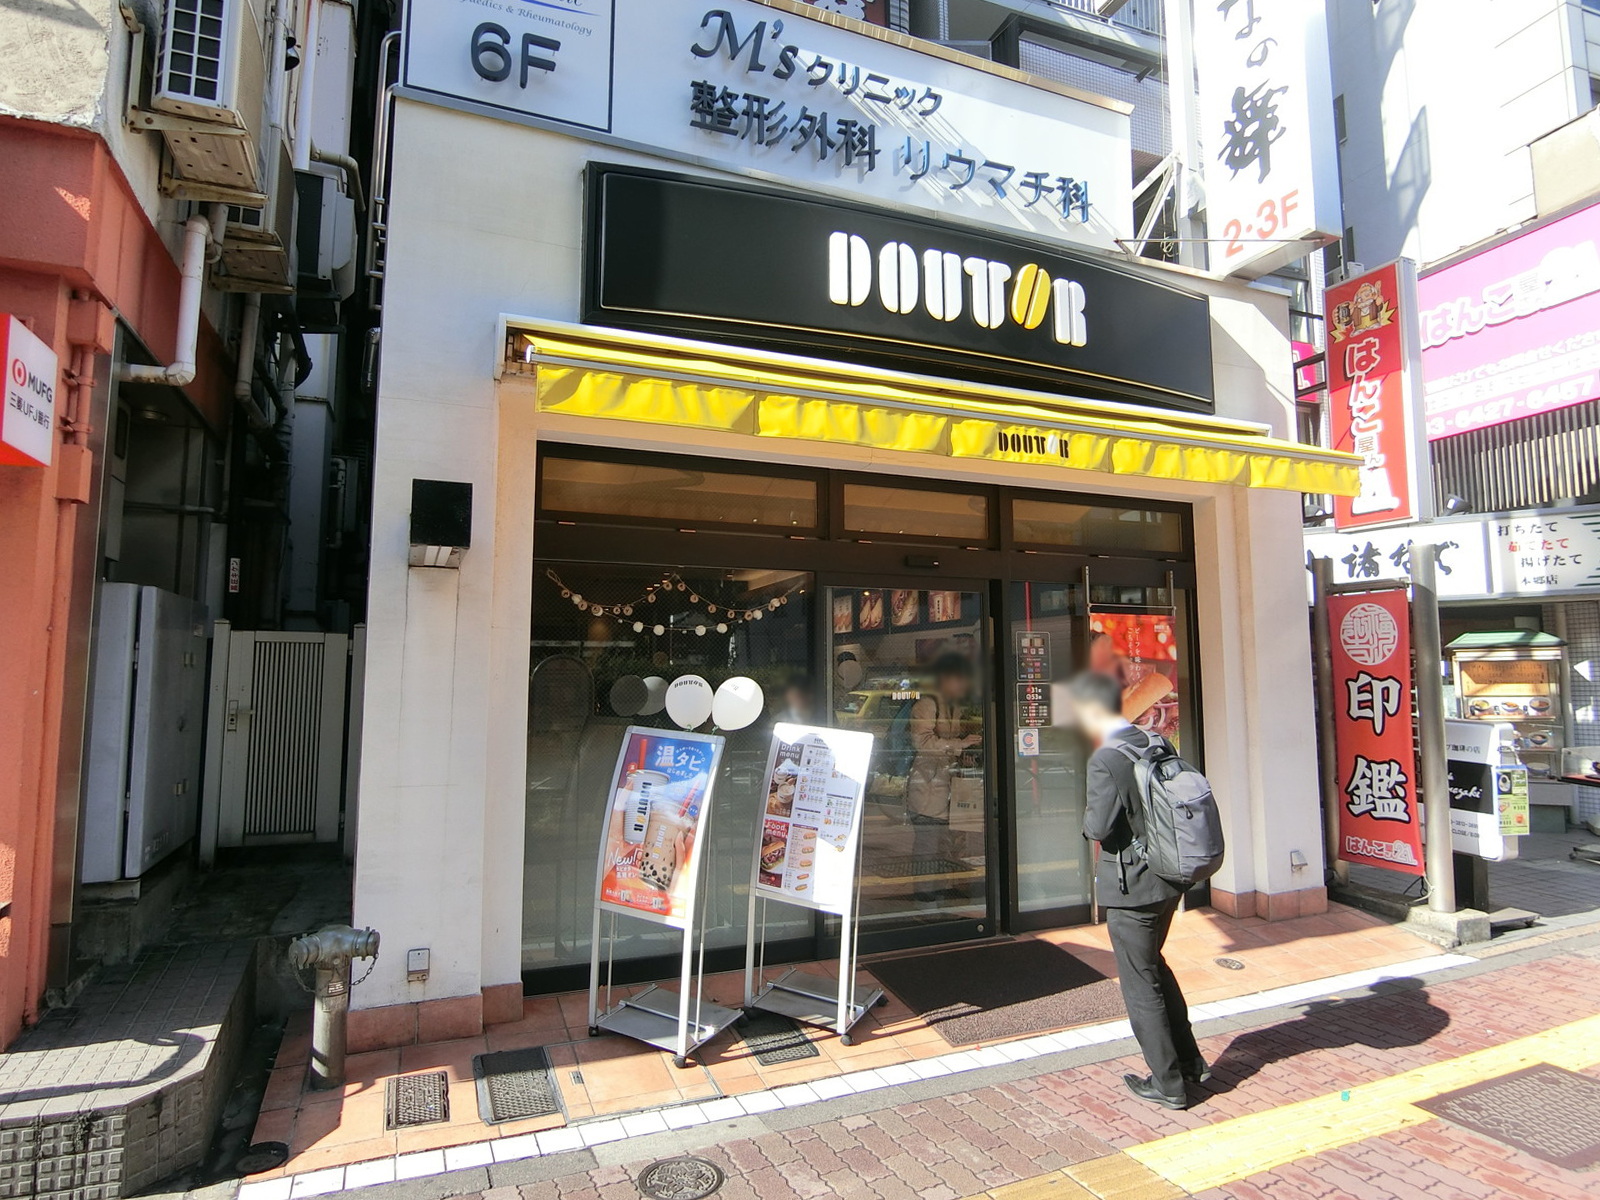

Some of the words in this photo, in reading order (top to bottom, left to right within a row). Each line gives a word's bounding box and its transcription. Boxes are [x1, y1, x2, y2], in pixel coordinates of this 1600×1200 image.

[517, 8, 593, 36] Rheumatology
[470, 22, 562, 89] 6F
[689, 79, 882, 172] 整形外科
[899, 135, 1094, 225] リウマチ科
[829, 231, 1087, 347] DOUTOR
[28, 371, 53, 403] MUFG
[9, 391, 50, 430] 三菱UFJ銀行
[998, 431, 1069, 458] DOUTOR
[1497, 521, 1559, 537] 打ちたて
[674, 680, 704, 689] DOUTOR
[892, 691, 921, 700] DOUTOR
[654, 745, 706, 772] 温タピ
[780, 751, 800, 759] menu
[781, 744, 801, 753] Drink
[1346, 670, 1410, 824] 印鑑
[633, 782, 652, 832] DOUTOR
